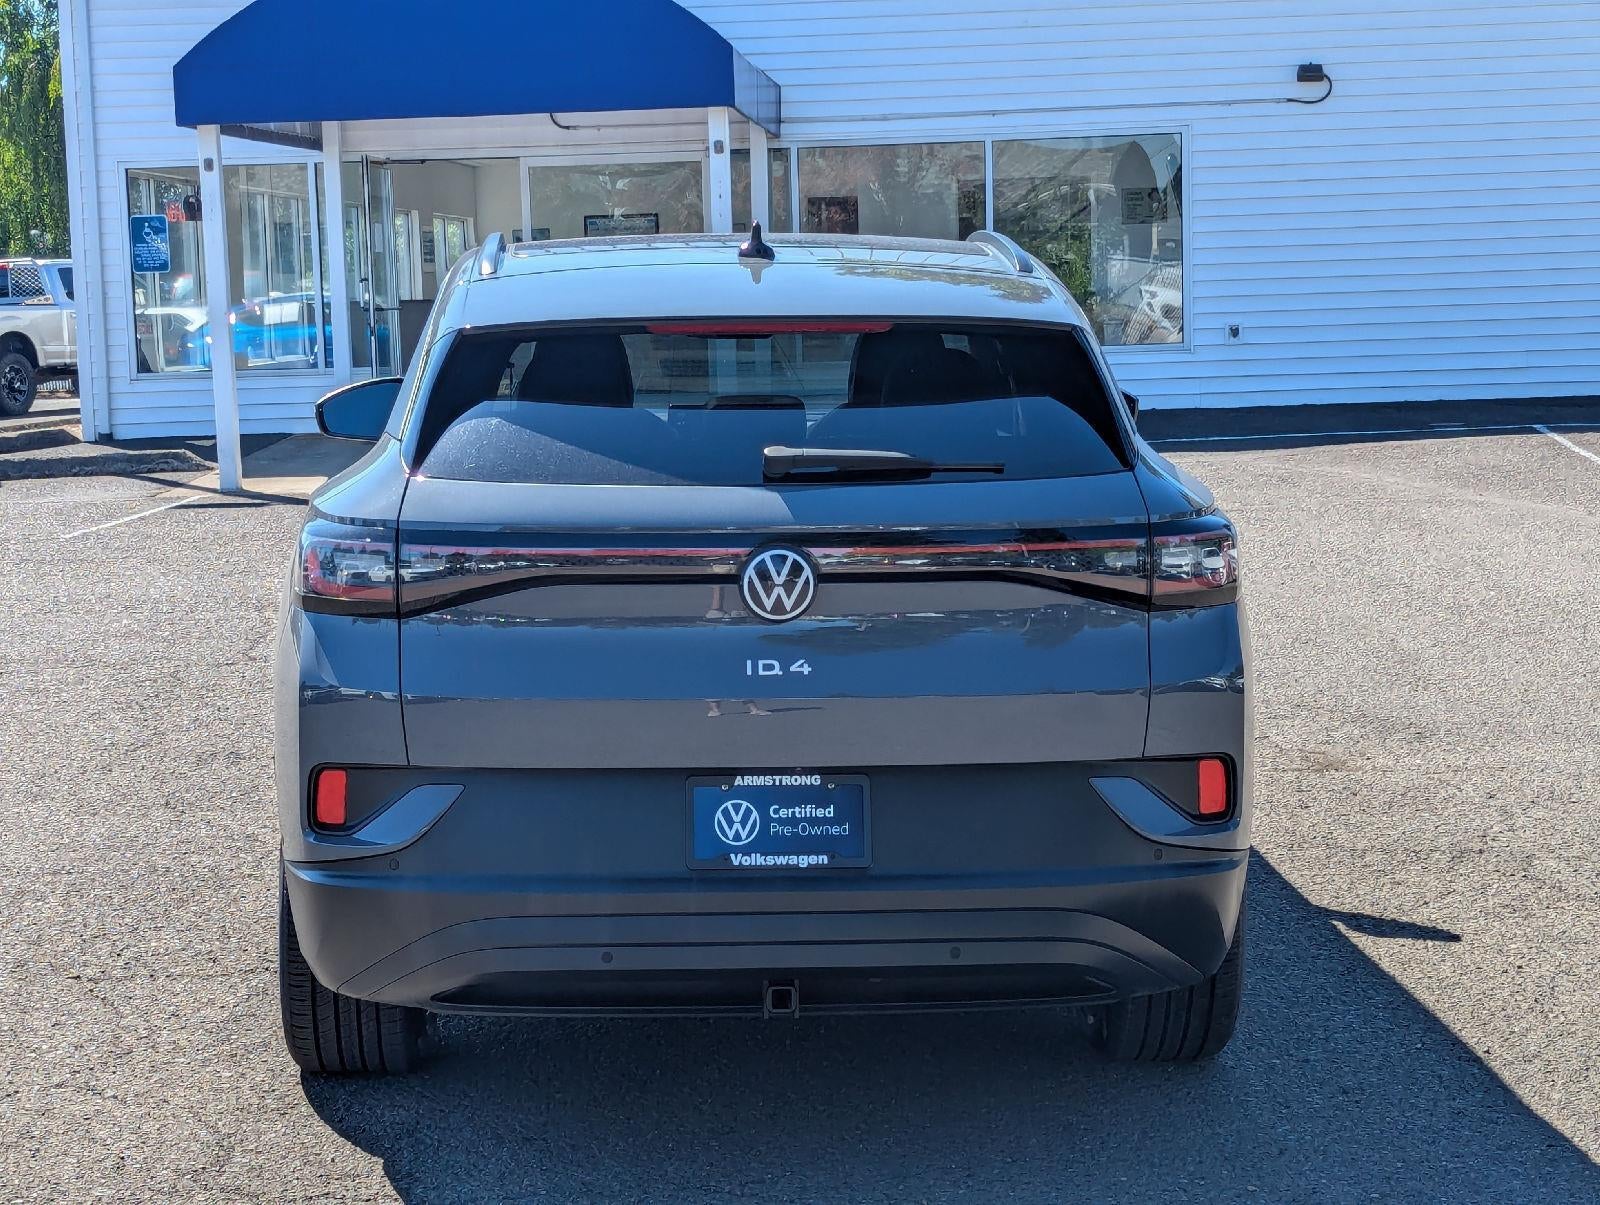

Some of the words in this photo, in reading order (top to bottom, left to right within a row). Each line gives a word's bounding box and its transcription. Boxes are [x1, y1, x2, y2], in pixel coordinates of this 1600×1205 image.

[734, 775, 821, 786] ARMSTRONG
[769, 804, 834, 818] Certified
[769, 822, 849, 836] Pre-Owned
[730, 853, 829, 867] Volkswagen
